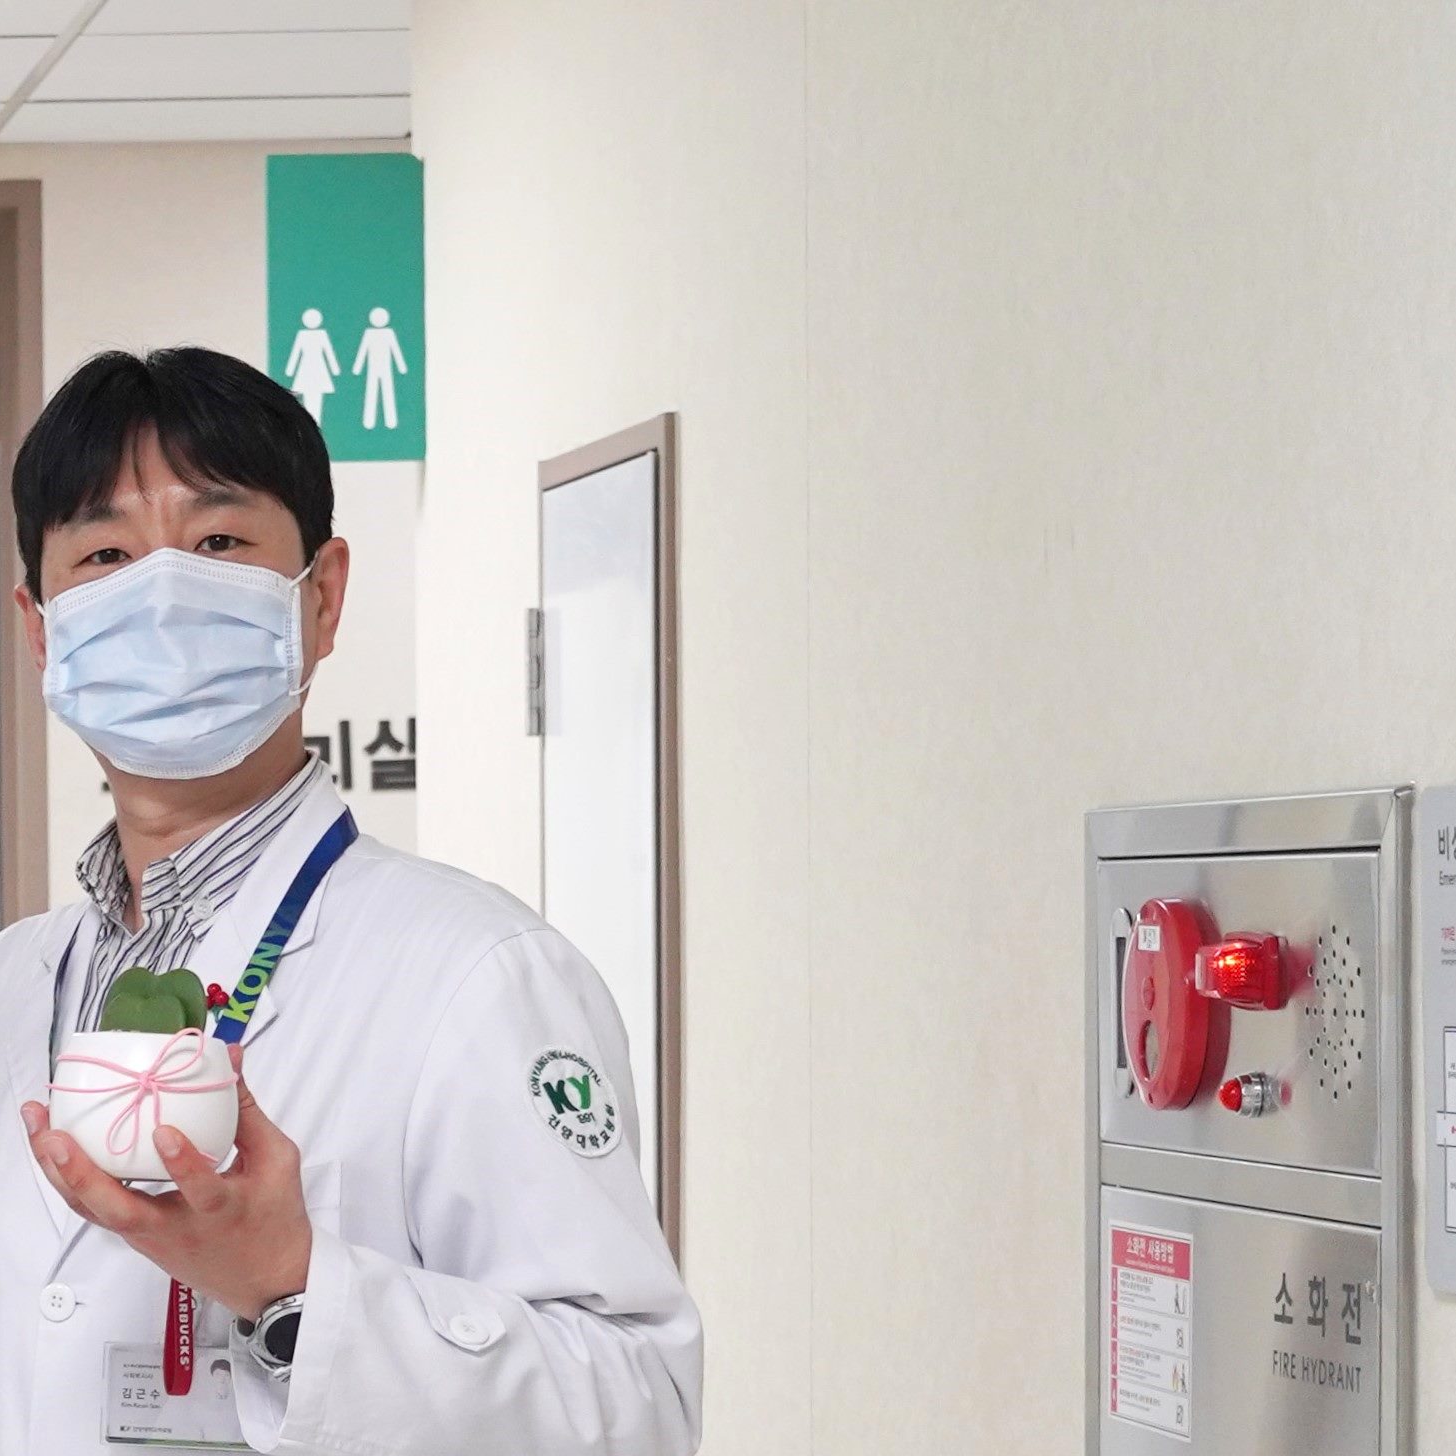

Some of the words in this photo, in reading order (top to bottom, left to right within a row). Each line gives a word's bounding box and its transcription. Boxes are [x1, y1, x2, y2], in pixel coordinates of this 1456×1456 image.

[542, 1074, 592, 1115] KY
[1273, 1272, 1362, 1345] 소화전
[1272, 1349, 1296, 1380] FIRE
[1301, 1355, 1362, 1394] HYDRANT
[122, 1387, 161, 1400] 김근수
